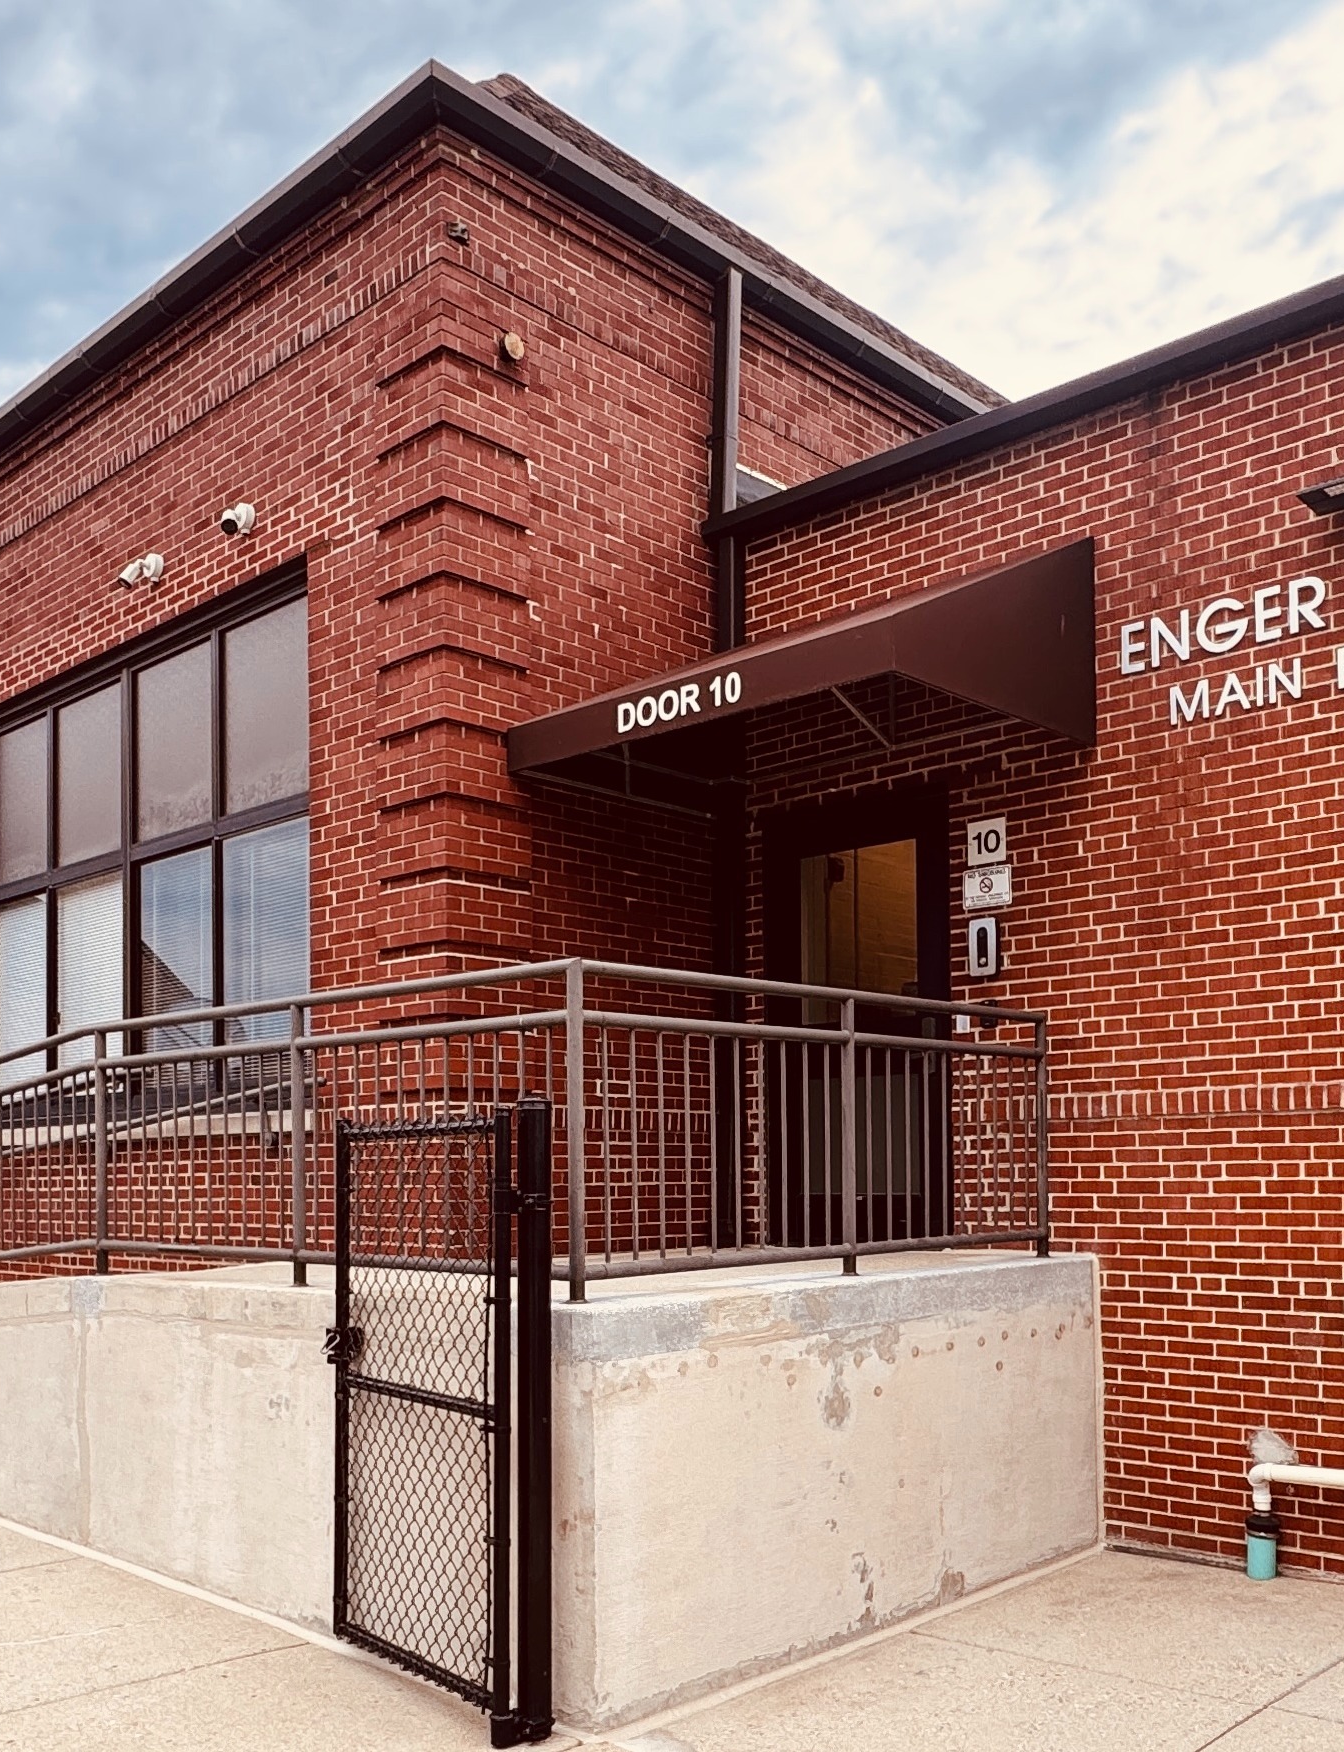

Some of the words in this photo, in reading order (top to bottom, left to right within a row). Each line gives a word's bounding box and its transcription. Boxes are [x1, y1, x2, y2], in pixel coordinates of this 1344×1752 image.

[1120, 576, 1327, 675] ENGER
[617, 683, 701, 734] DOOR
[709, 671, 742, 707] 10
[1169, 657, 1303, 726] MAIN
[972, 829, 1001, 855] 10
